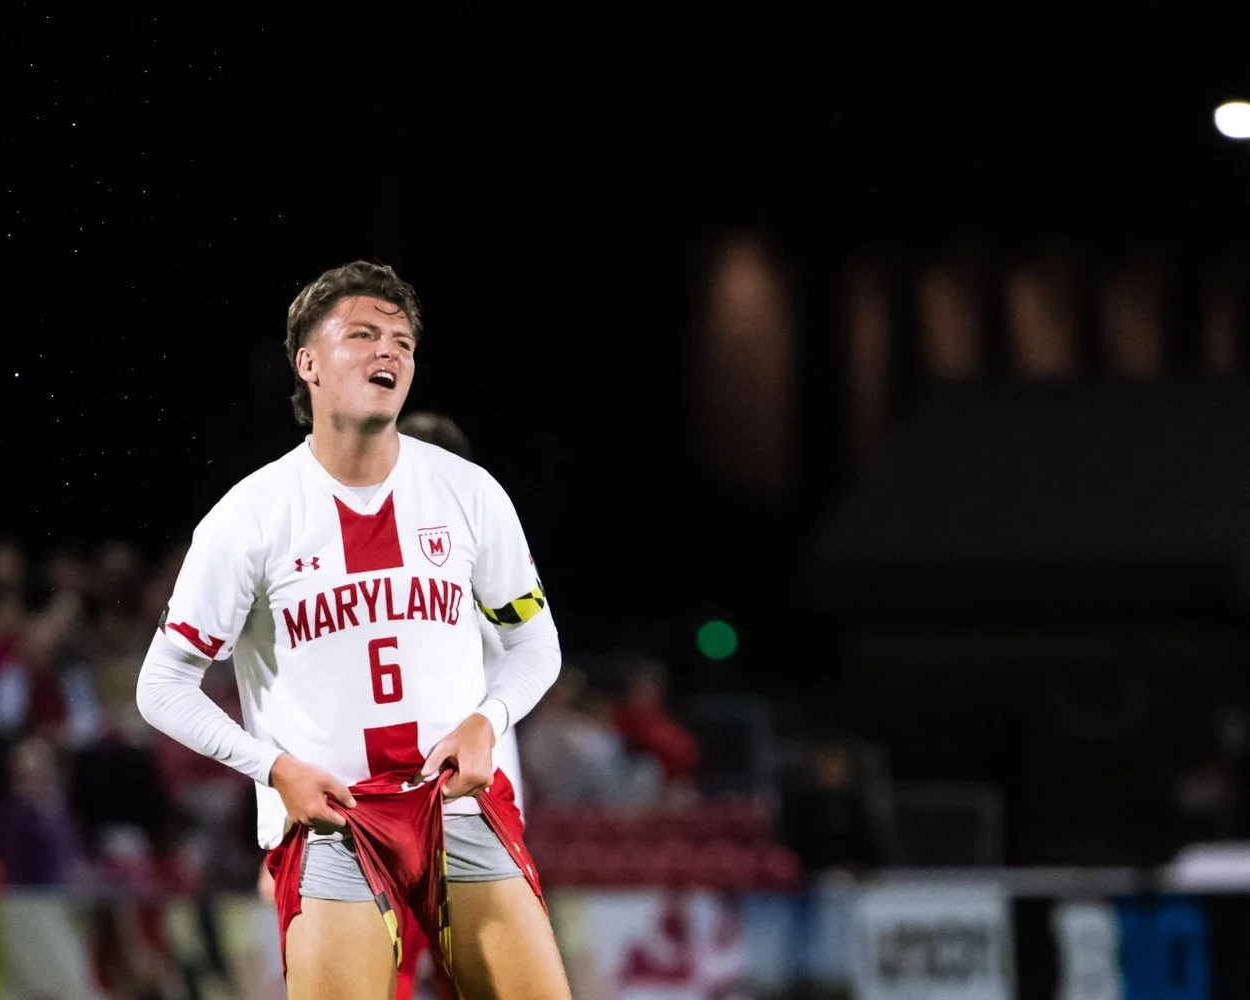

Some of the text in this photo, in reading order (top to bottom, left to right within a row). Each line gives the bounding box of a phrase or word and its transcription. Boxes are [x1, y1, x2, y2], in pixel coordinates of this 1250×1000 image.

[428, 537, 445, 554] M
[282, 576, 463, 650] MARYLAND
[368, 636, 404, 705] 6
